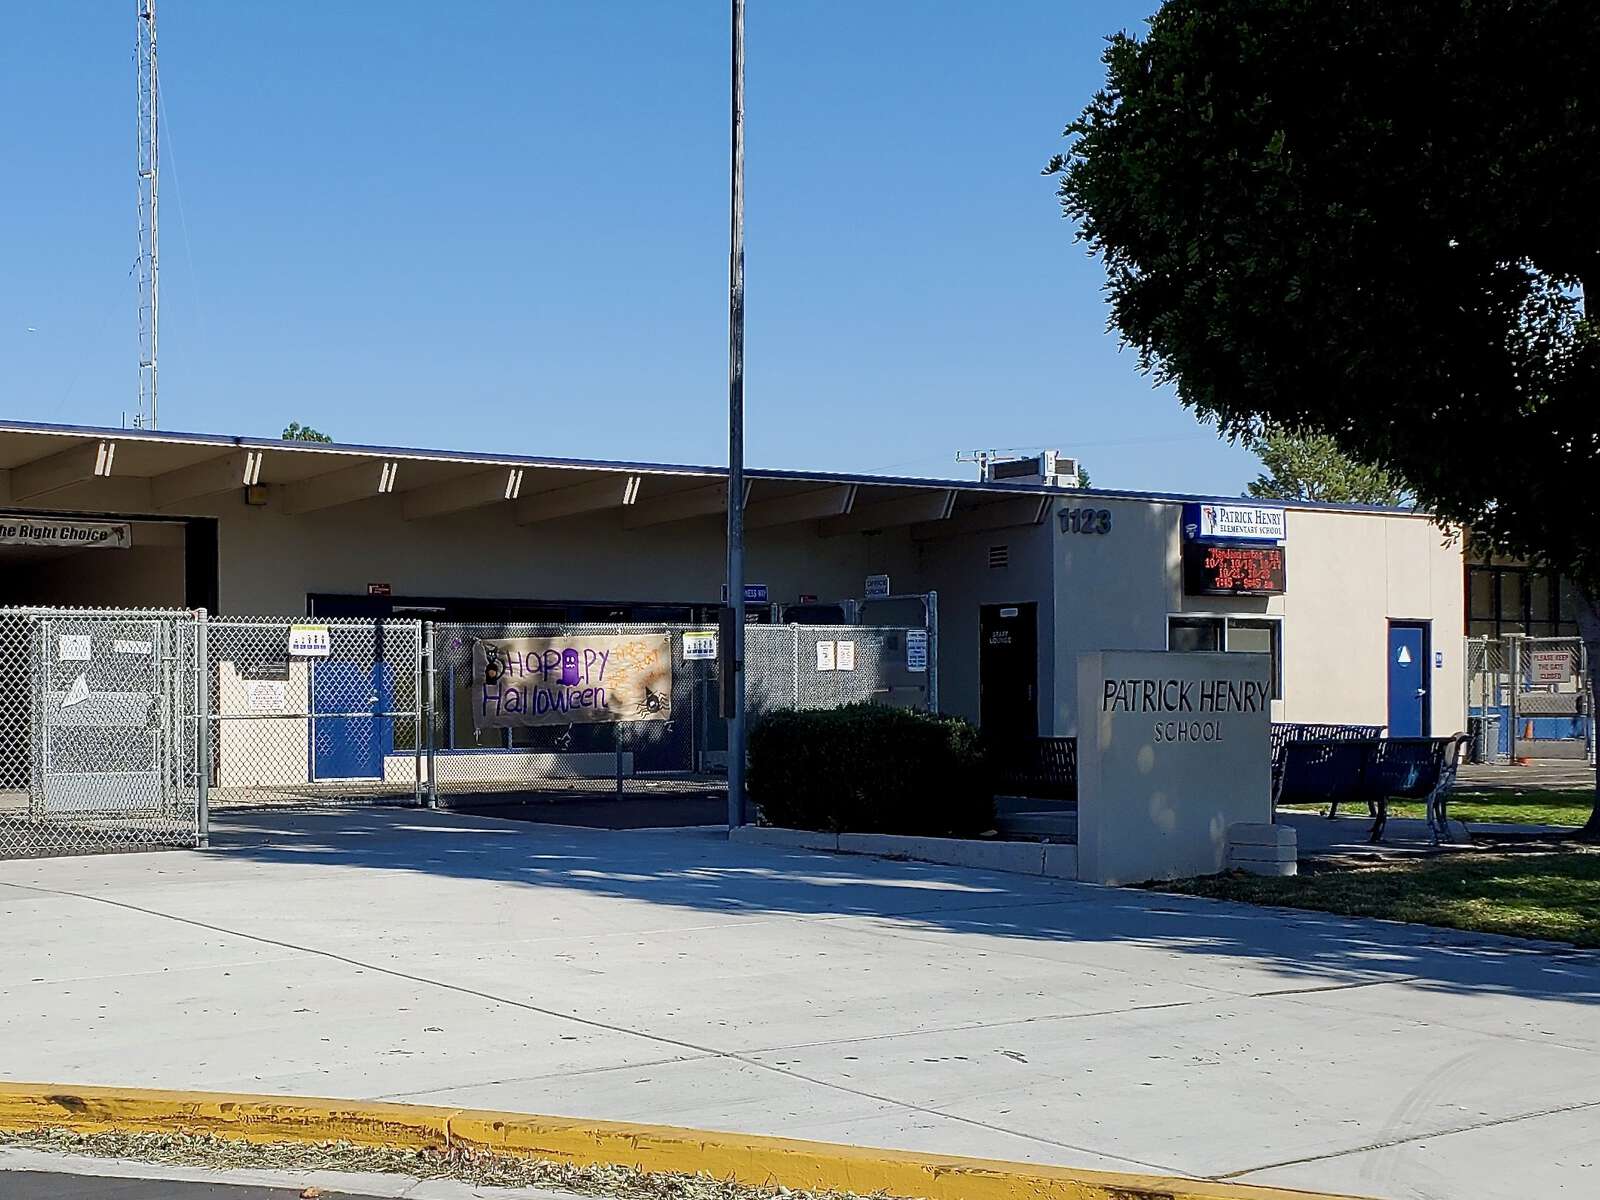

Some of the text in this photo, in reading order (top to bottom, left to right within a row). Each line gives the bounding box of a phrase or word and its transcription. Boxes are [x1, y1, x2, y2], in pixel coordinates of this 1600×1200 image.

[1056, 508, 1112, 534] 1123
[0, 524, 108, 541] he Right Choice
[1219, 524, 1282, 536] ELEMENTARY SCHOOL
[1533, 654, 1554, 662] PLEASE
[1538, 663, 1564, 671] THE GATE
[1101, 679, 1271, 713] PATRICK HENRY
[1153, 721, 1224, 743] SCHOOL
